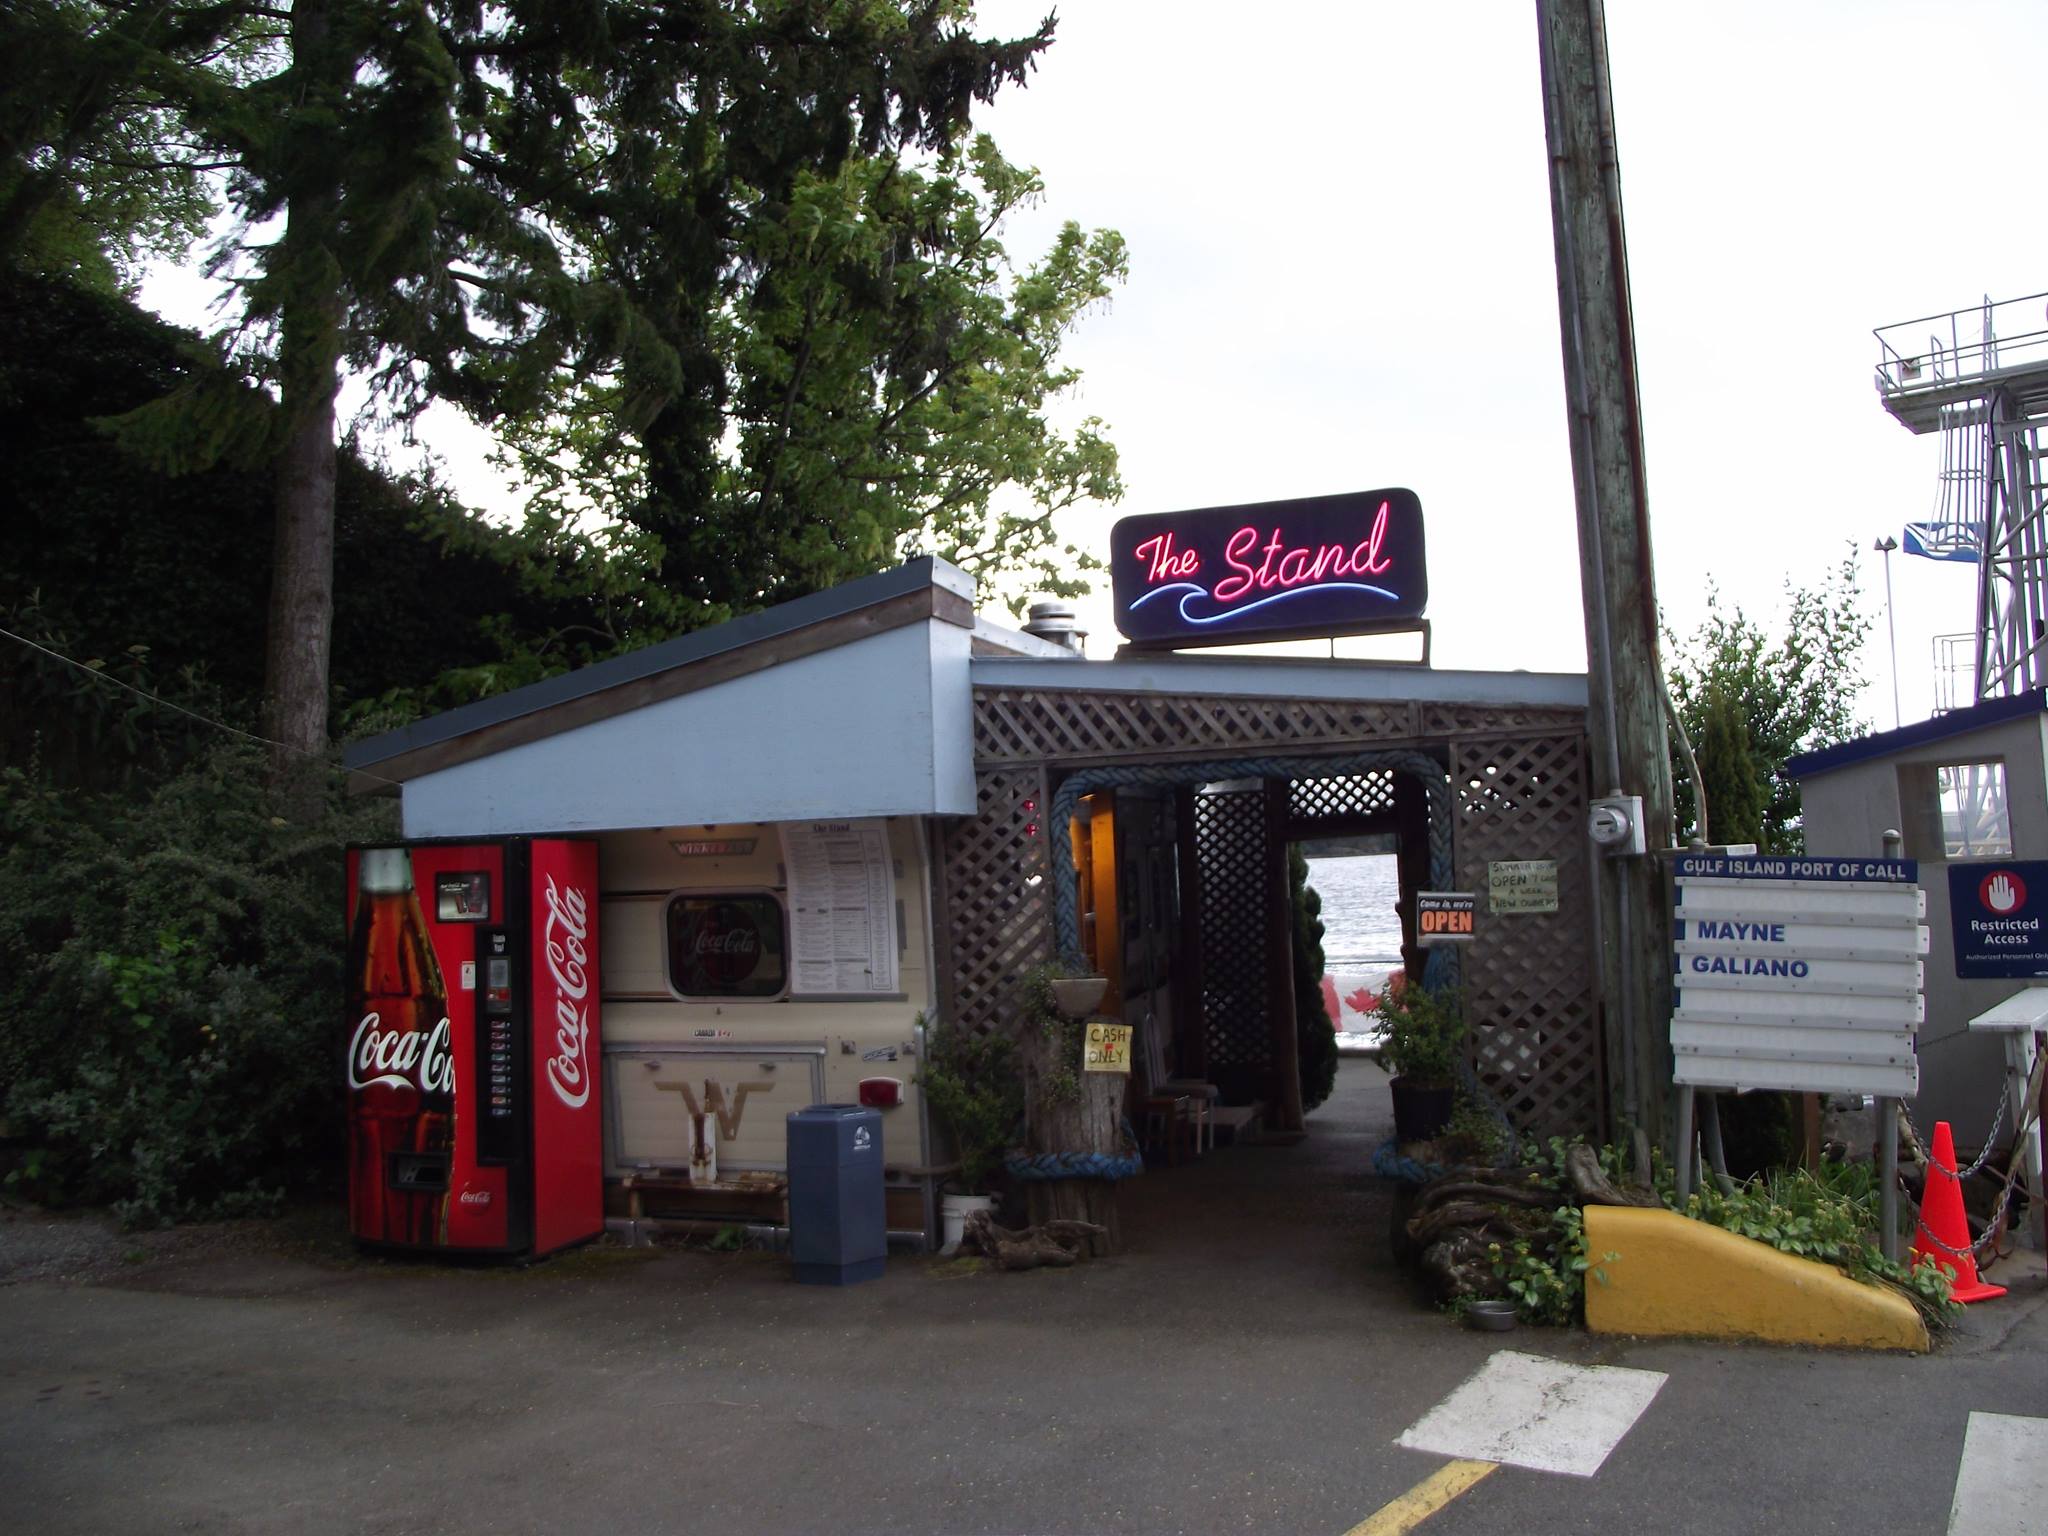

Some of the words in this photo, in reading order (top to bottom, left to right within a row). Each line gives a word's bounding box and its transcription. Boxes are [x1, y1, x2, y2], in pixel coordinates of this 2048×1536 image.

[1136, 532, 1199, 582] The
[1214, 500, 1391, 602] Stand
[673, 841, 754, 855] WINNEB
[1682, 858, 1724, 874] GULF
[1728, 860, 1786, 876] ISLAND
[1790, 862, 1834, 877] PORT
[1838, 863, 1860, 877] OF
[1864, 863, 1907, 879] CALL
[1491, 875, 1527, 887] OPEN
[1420, 899, 1440, 909] Come
[1453, 900, 1474, 909] we're
[1421, 910, 1473, 932] OPEN
[1970, 917, 2039, 931] Restricted
[1697, 921, 1786, 942] MAYNE
[1984, 933, 2029, 944] Access
[2034, 952, 2048, 960] Onl
[1691, 955, 1809, 978] GALIANO
[546, 872, 591, 1108] Coca-Cola
[1091, 1028, 1126, 1042] CASH
[1089, 1050, 1124, 1063] ONLY
